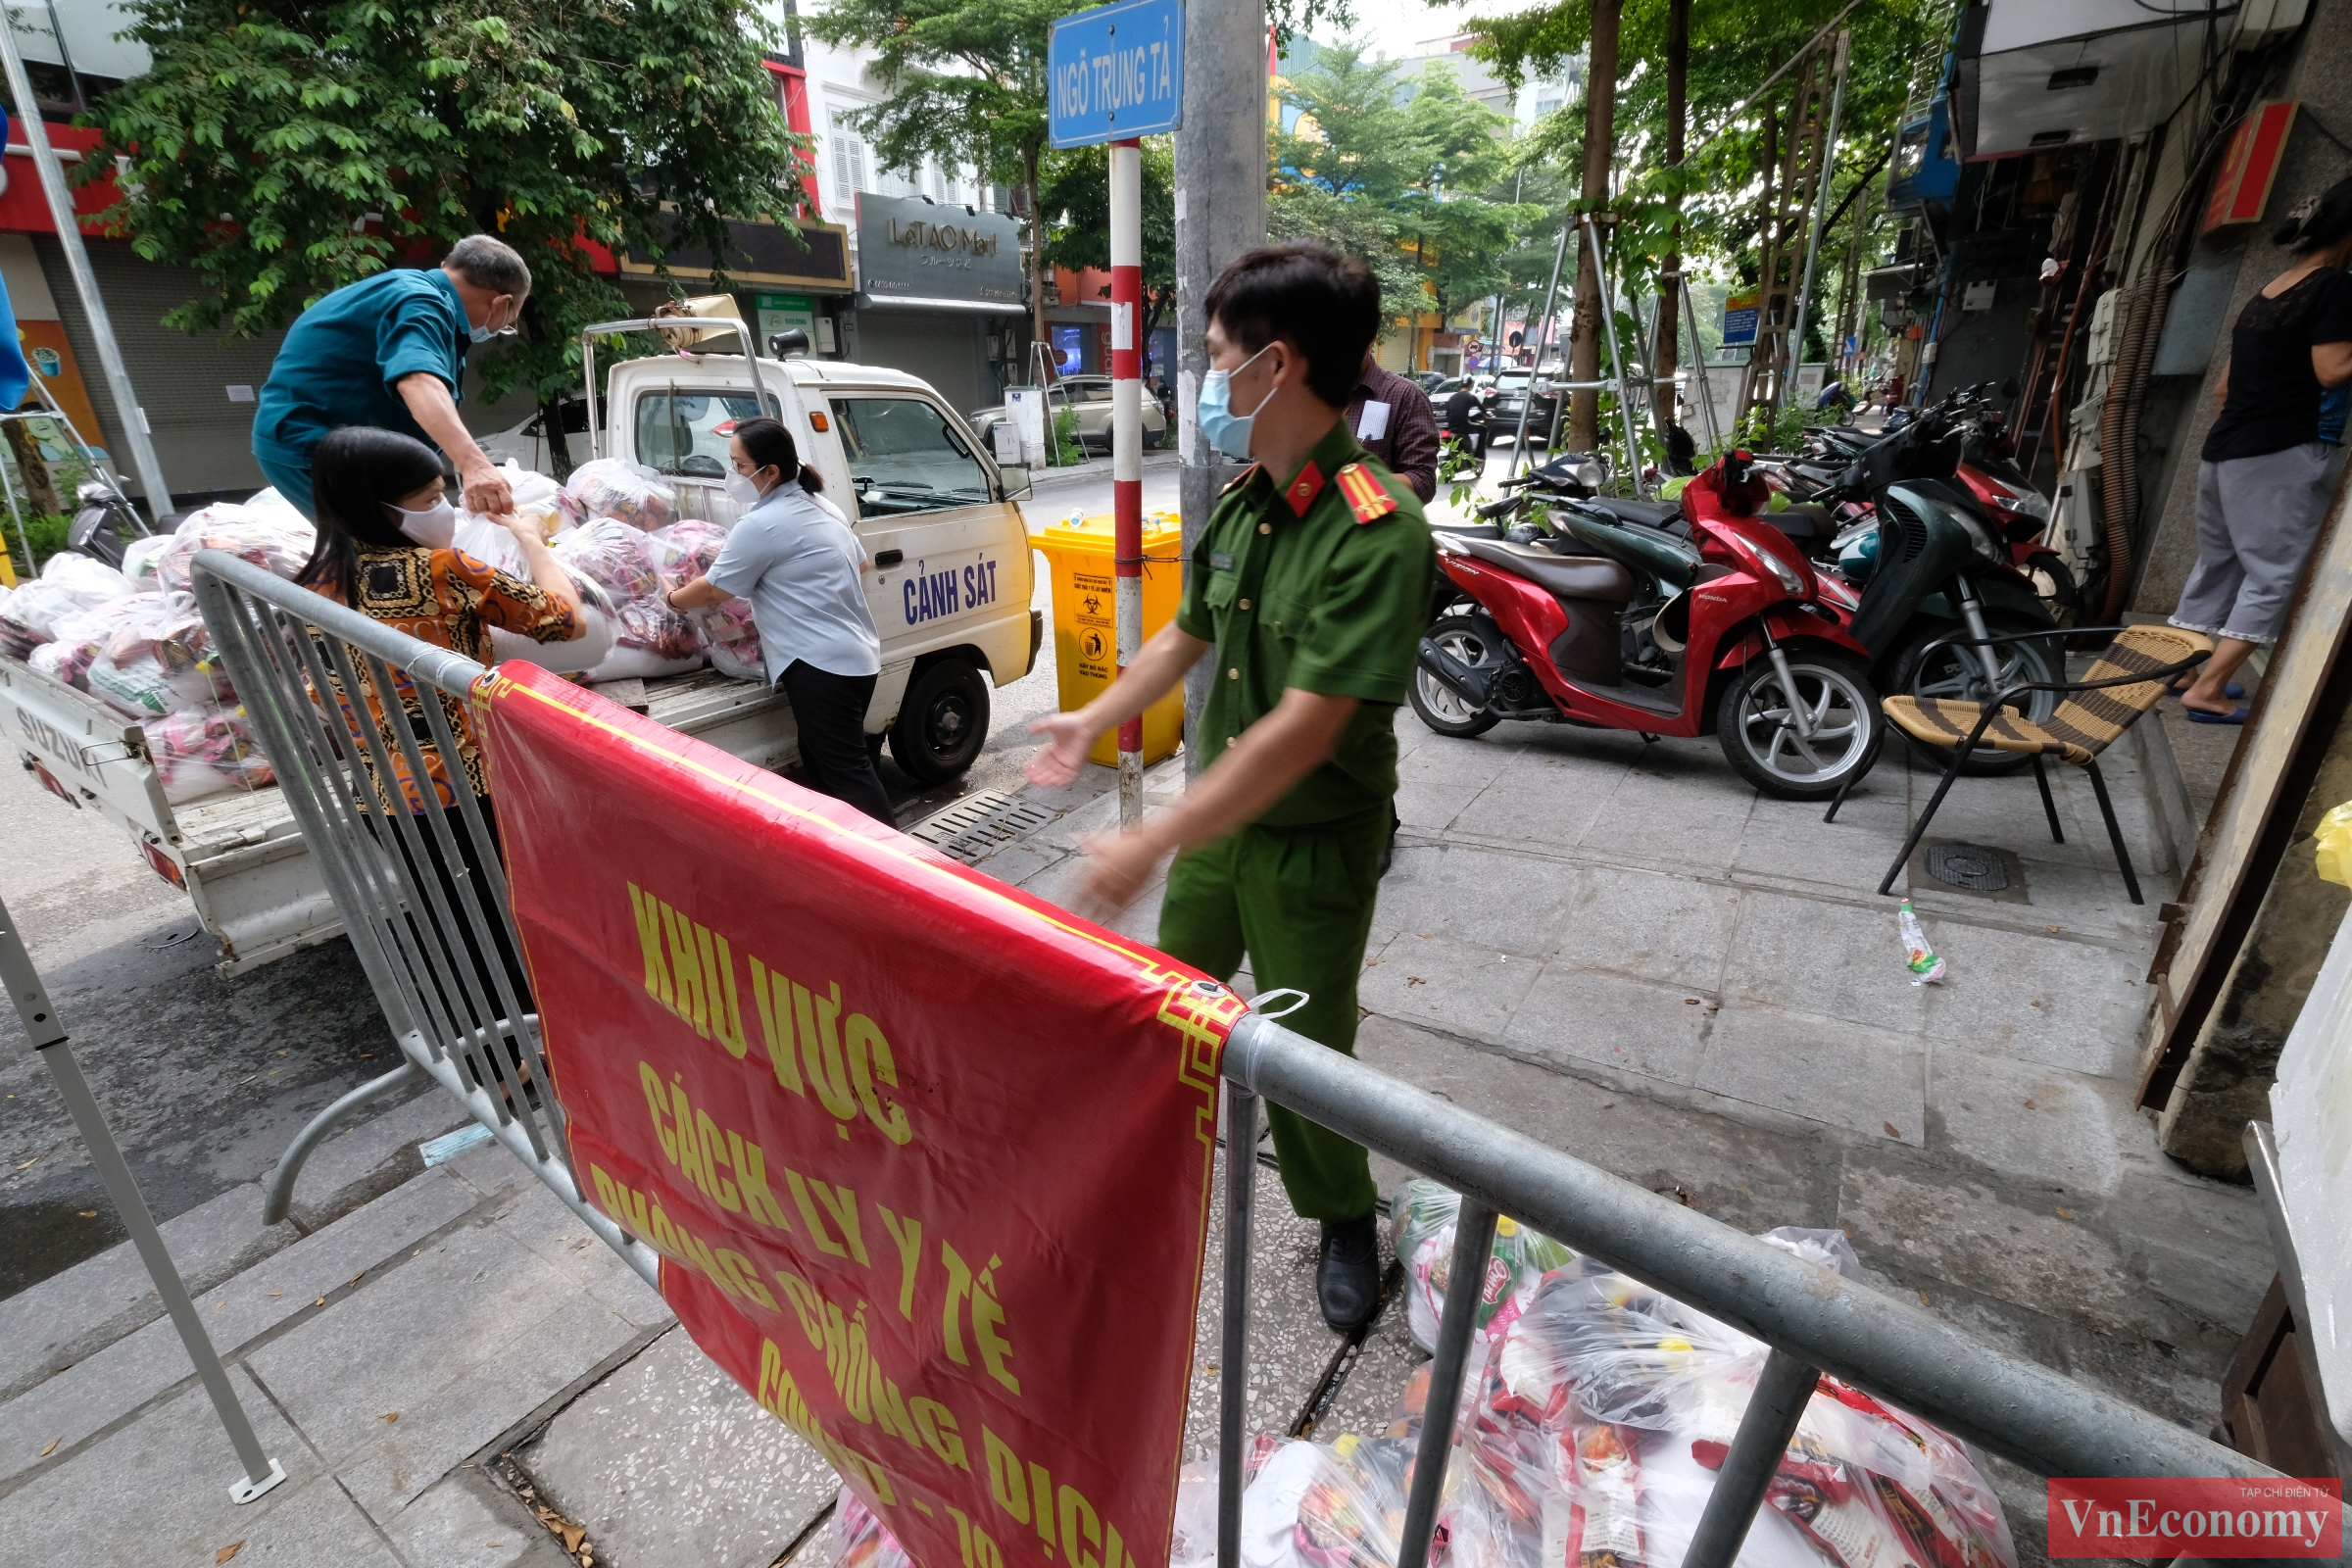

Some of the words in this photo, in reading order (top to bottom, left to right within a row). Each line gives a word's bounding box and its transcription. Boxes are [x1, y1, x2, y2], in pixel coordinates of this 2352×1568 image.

[1057, 47, 1089, 119] NGÕ
[1093, 46, 1146, 112] TRUNG
[1150, 15, 1171, 102] TẢ
[960, 226, 999, 257] Mart
[904, 560, 959, 625] CẢNH
[963, 552, 997, 610] SÁT
[1445, 557, 1480, 575] VISION
[1698, 593, 1728, 603] HONDA
[16, 707, 109, 790] SUZUKI
[627, 879, 748, 1059] KHU
[748, 954, 912, 1146] VỰC
[639, 1060, 794, 1234] CÁCH
[783, 1166, 871, 1269] LY
[875, 1201, 922, 1323] Y
[941, 1238, 1021, 1397] TẾ
[590, 1161, 783, 1314] PHÒNG
[774, 1269, 971, 1474] CHỐNG
